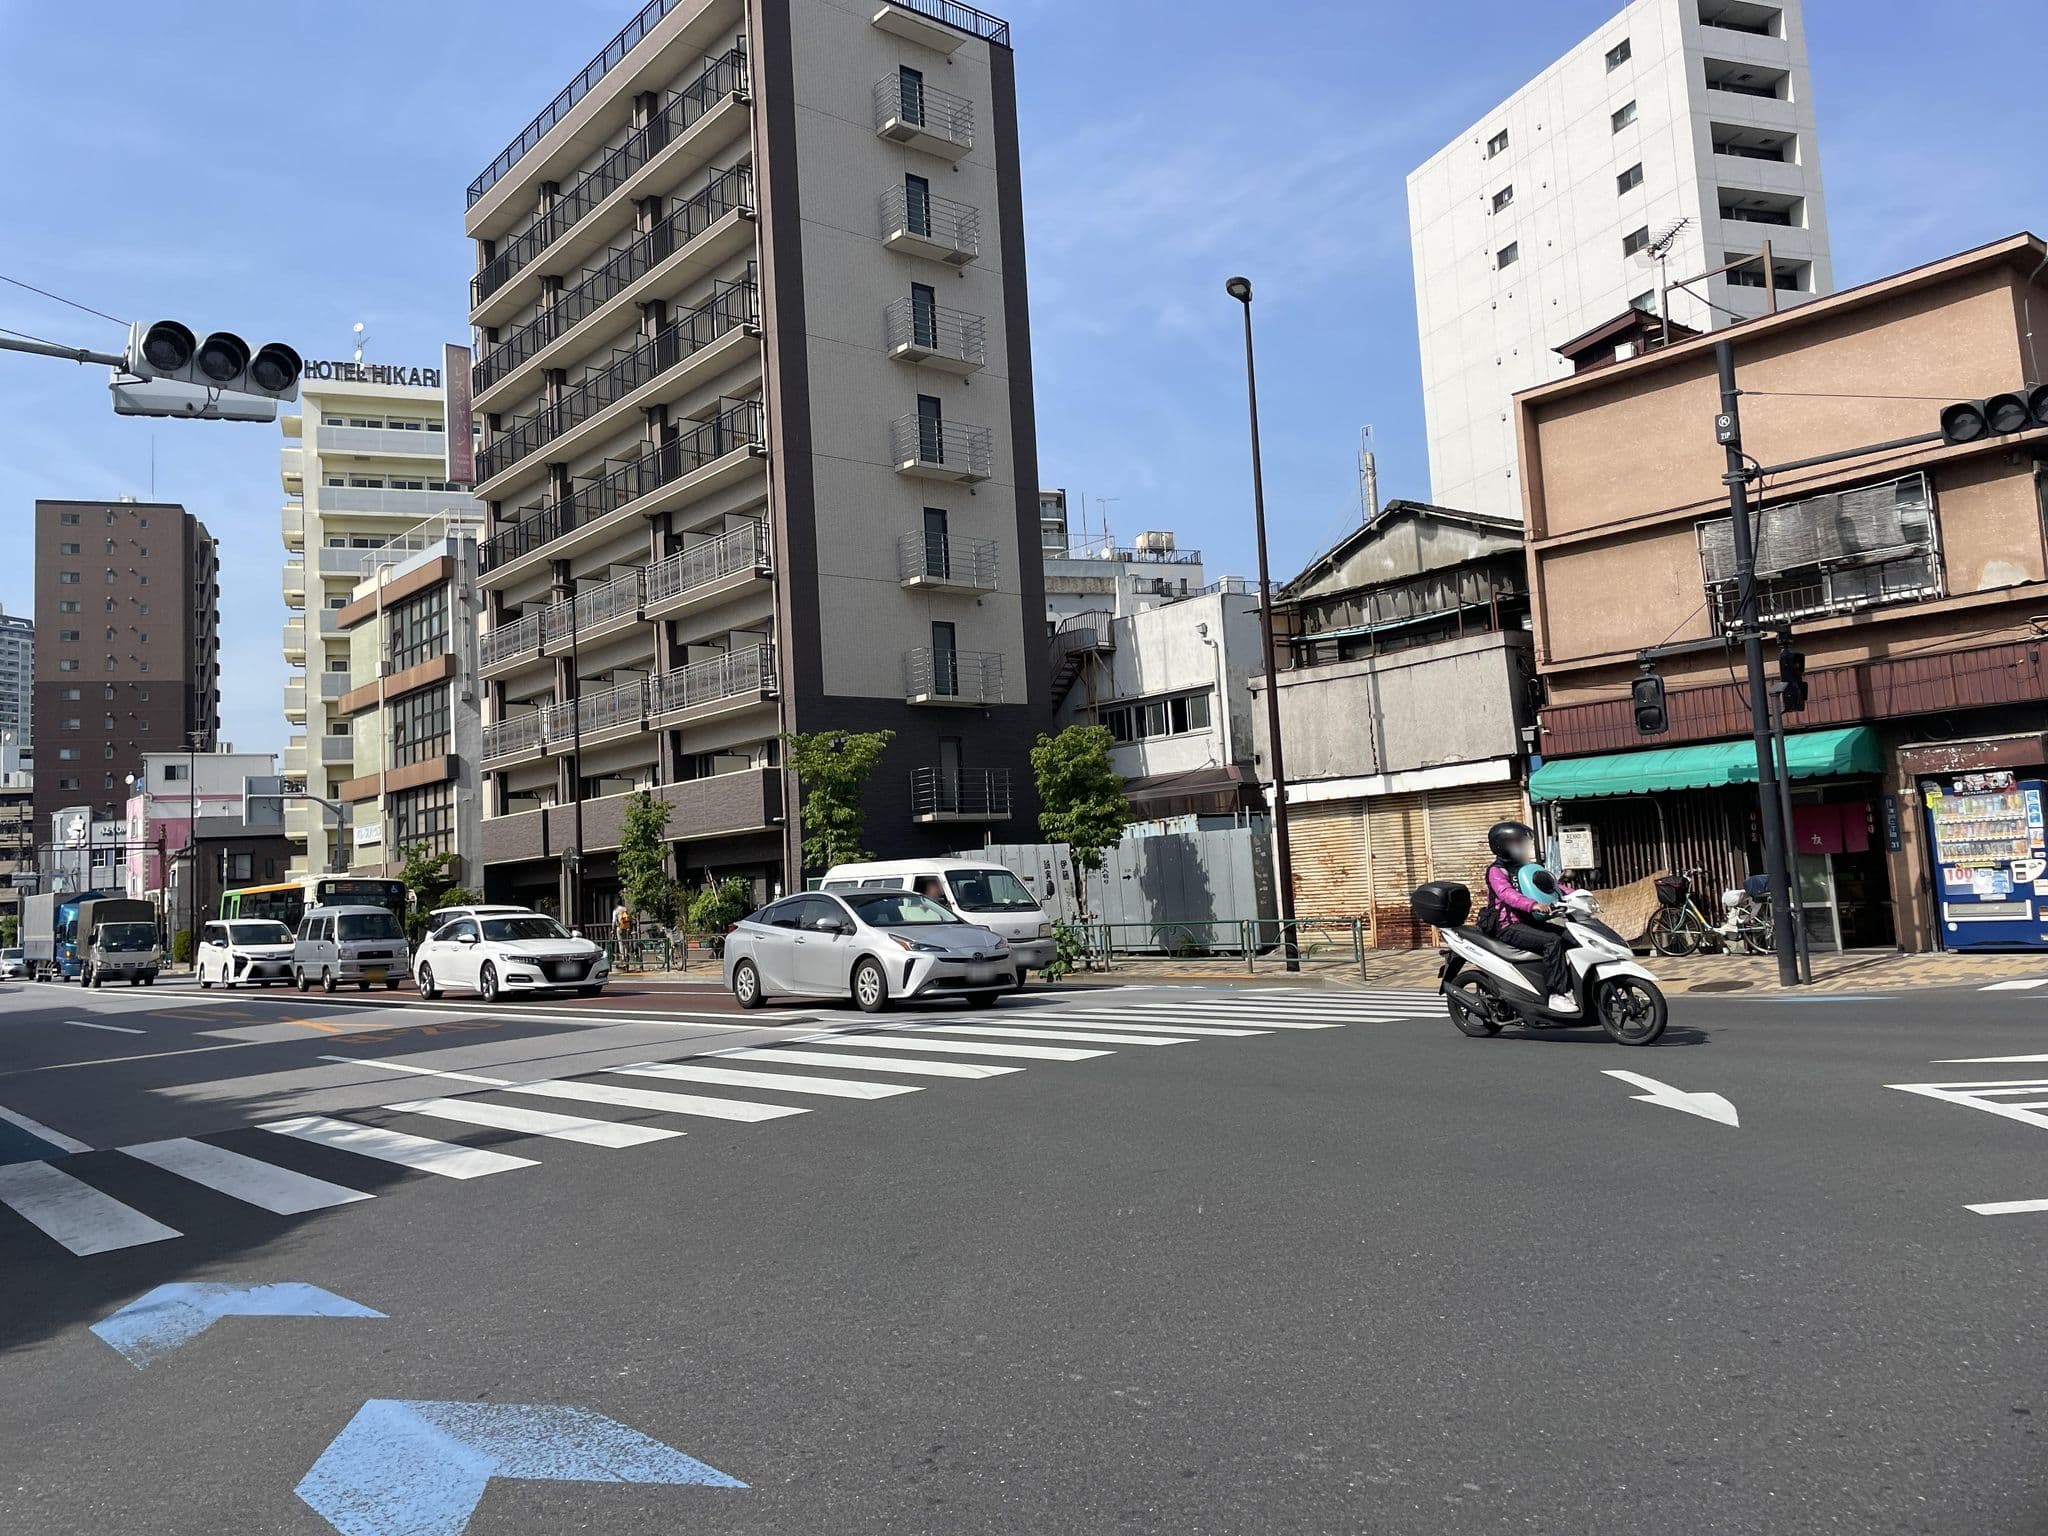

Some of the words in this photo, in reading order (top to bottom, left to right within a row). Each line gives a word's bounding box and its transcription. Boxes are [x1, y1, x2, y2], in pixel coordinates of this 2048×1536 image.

[304, 360, 367, 382] HOTEL
[372, 364, 441, 388] HIKARI
[1720, 432, 1730, 440] ZIP
[1947, 868, 1973, 880] 100
